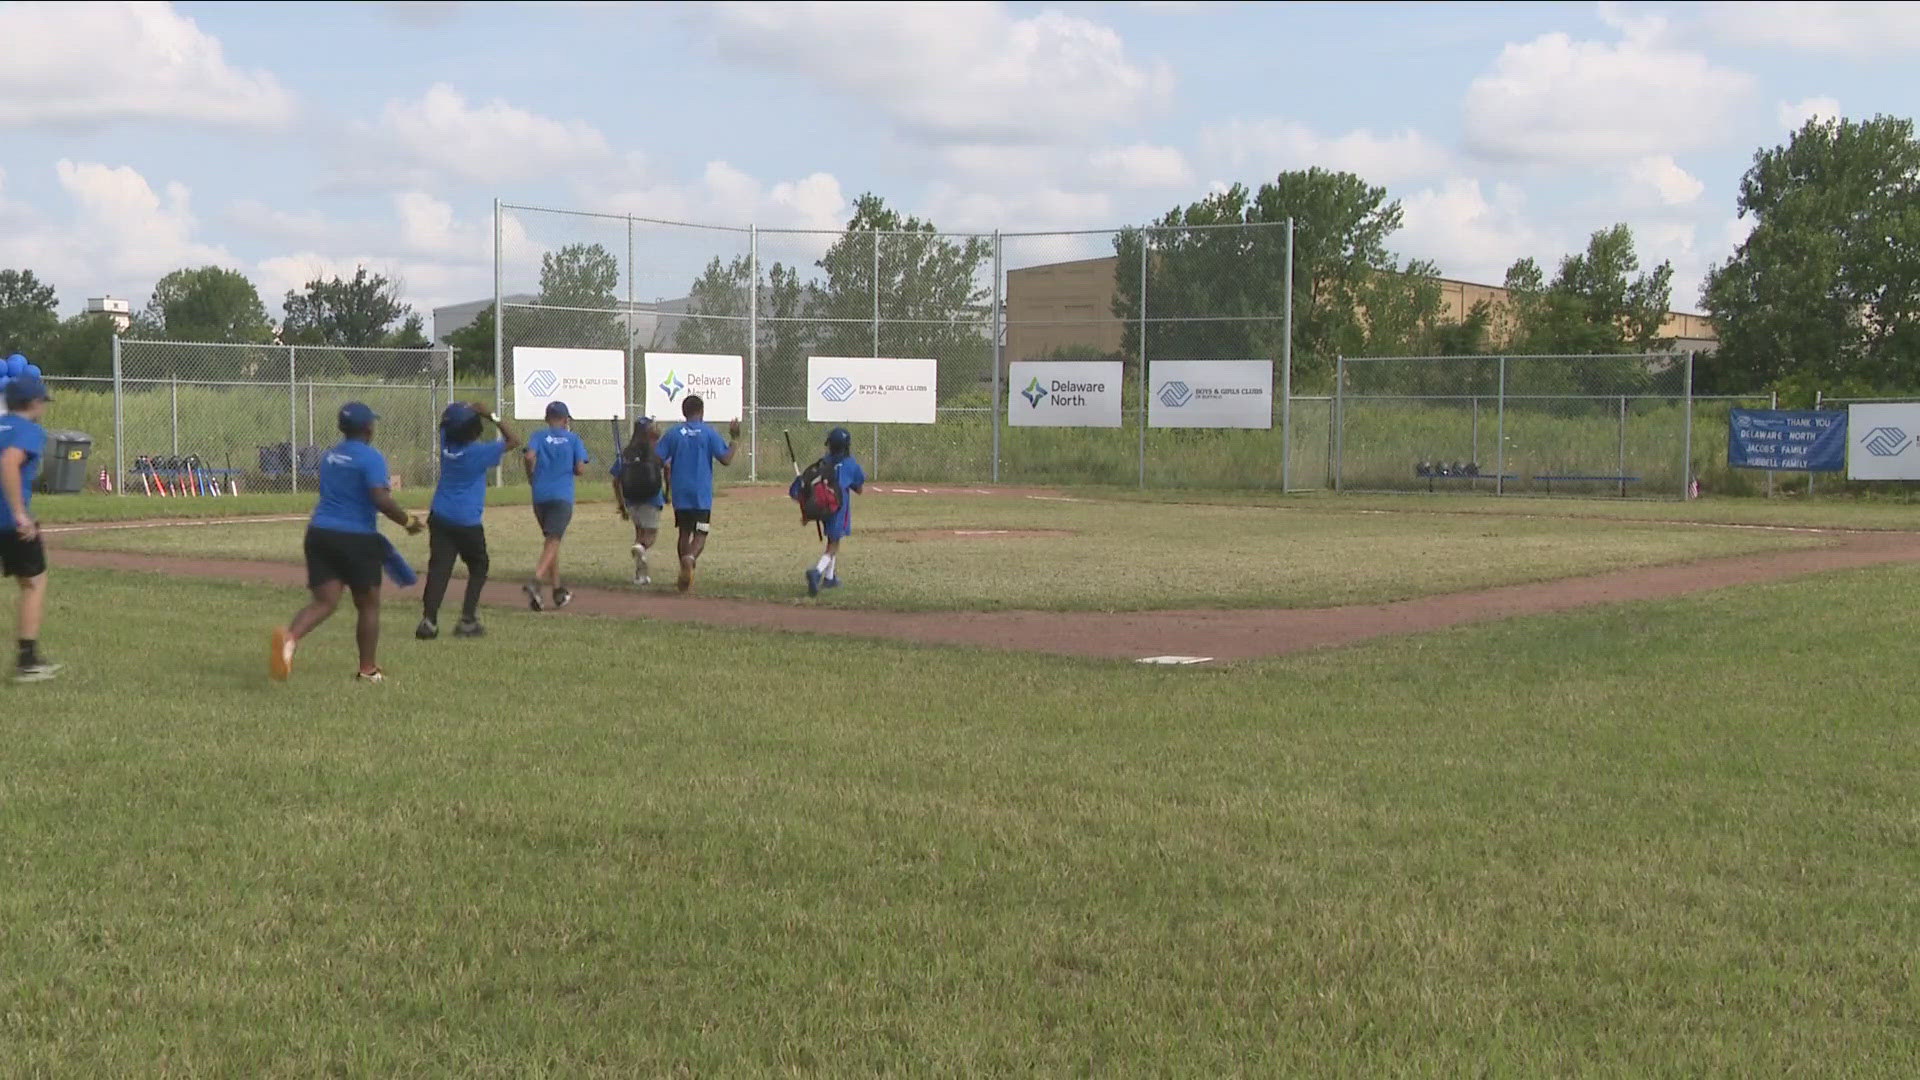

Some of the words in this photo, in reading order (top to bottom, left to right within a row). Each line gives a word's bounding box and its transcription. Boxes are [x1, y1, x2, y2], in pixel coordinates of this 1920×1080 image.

[687, 373, 731, 386] Delaware
[1051, 380, 1105, 393] Delaware
[687, 388, 716, 399] North
[1051, 394, 1086, 406] North
[1786, 418, 1811, 427] THANK
[1815, 418, 1831, 428] YOU
[1740, 430, 1782, 440] DELAWARE
[1789, 432, 1816, 441] NORTH
[1746, 444, 1775, 453] JACOBS
[1781, 445, 1808, 454] FAMILY
[1781, 459, 1808, 468] FAMILY
